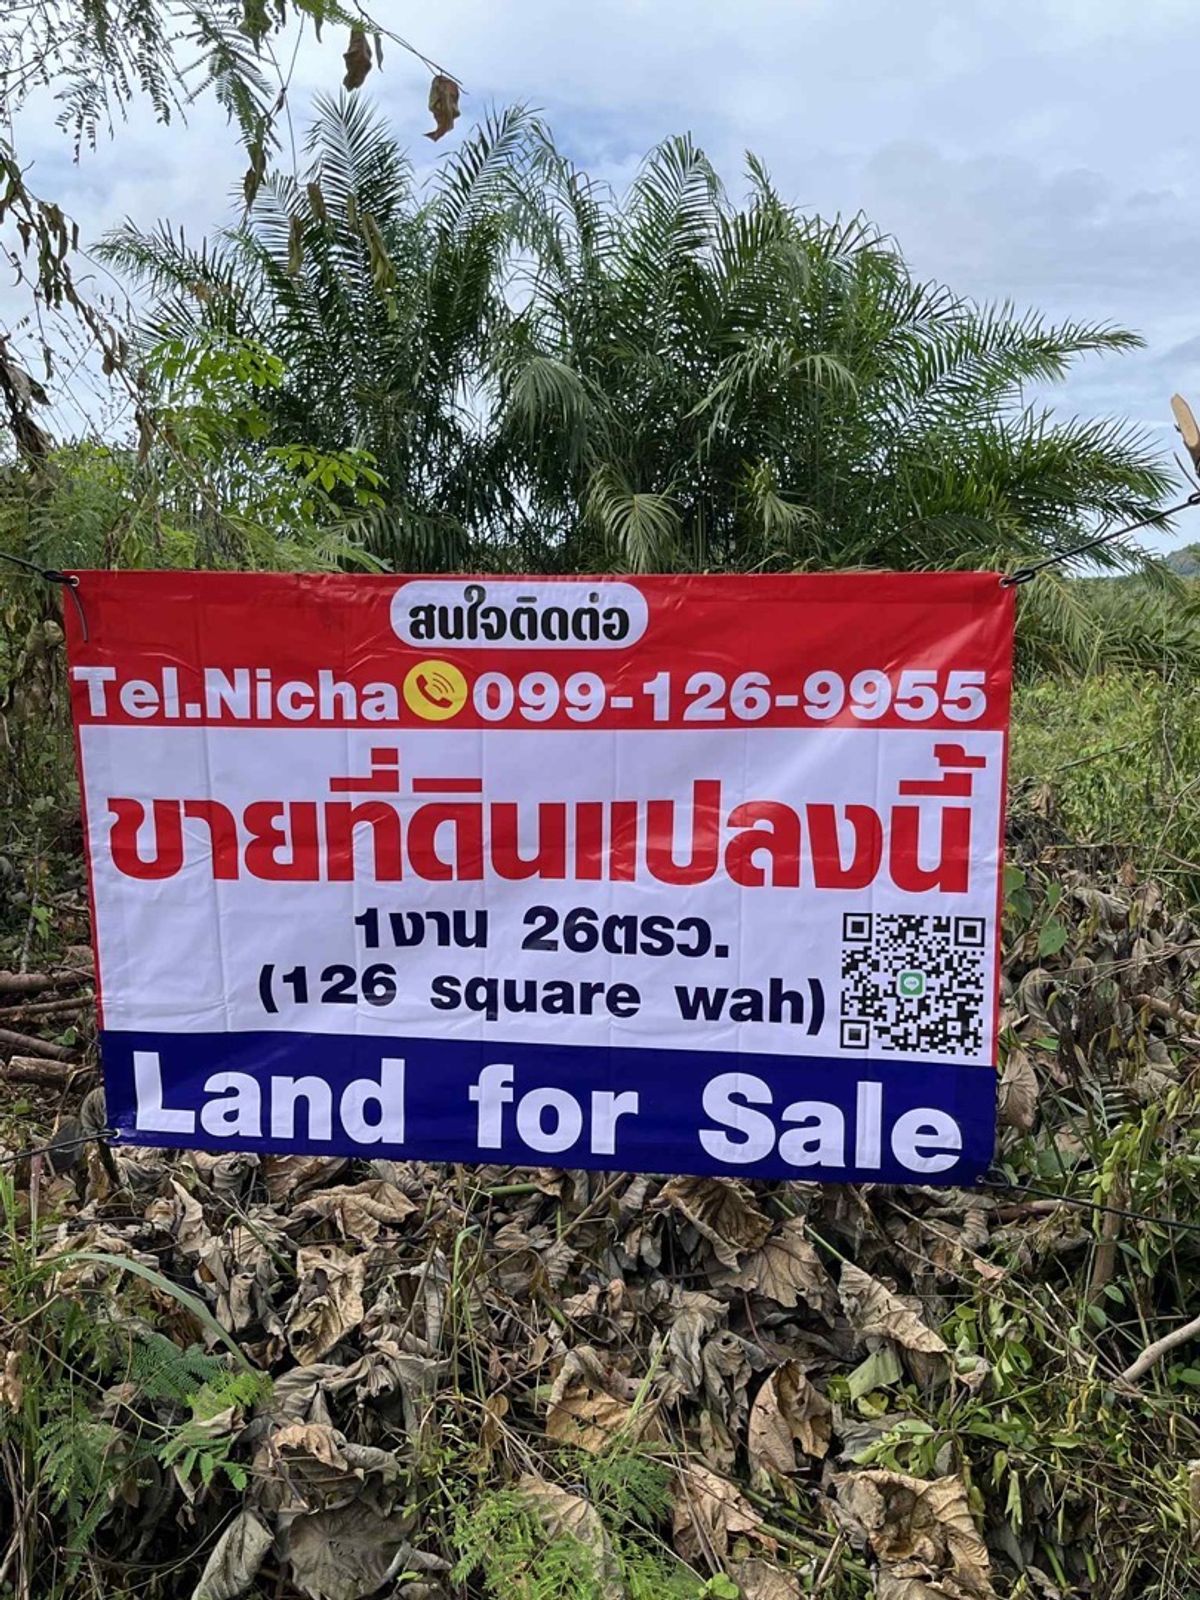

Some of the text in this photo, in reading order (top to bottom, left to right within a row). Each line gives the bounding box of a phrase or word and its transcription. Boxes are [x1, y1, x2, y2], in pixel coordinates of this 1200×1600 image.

[408, 584, 630, 642] สนใจติดต่อ
[73, 665, 987, 722] Tel.Nicha 099-126-9955
[106, 743, 987, 893] ขายที่ดินแปลงนี้
[354, 904, 730, 959] 1งาน 26ตรว.
[258, 962, 826, 1036] (126 square wah)
[132, 1050, 963, 1174] Land for Sale
